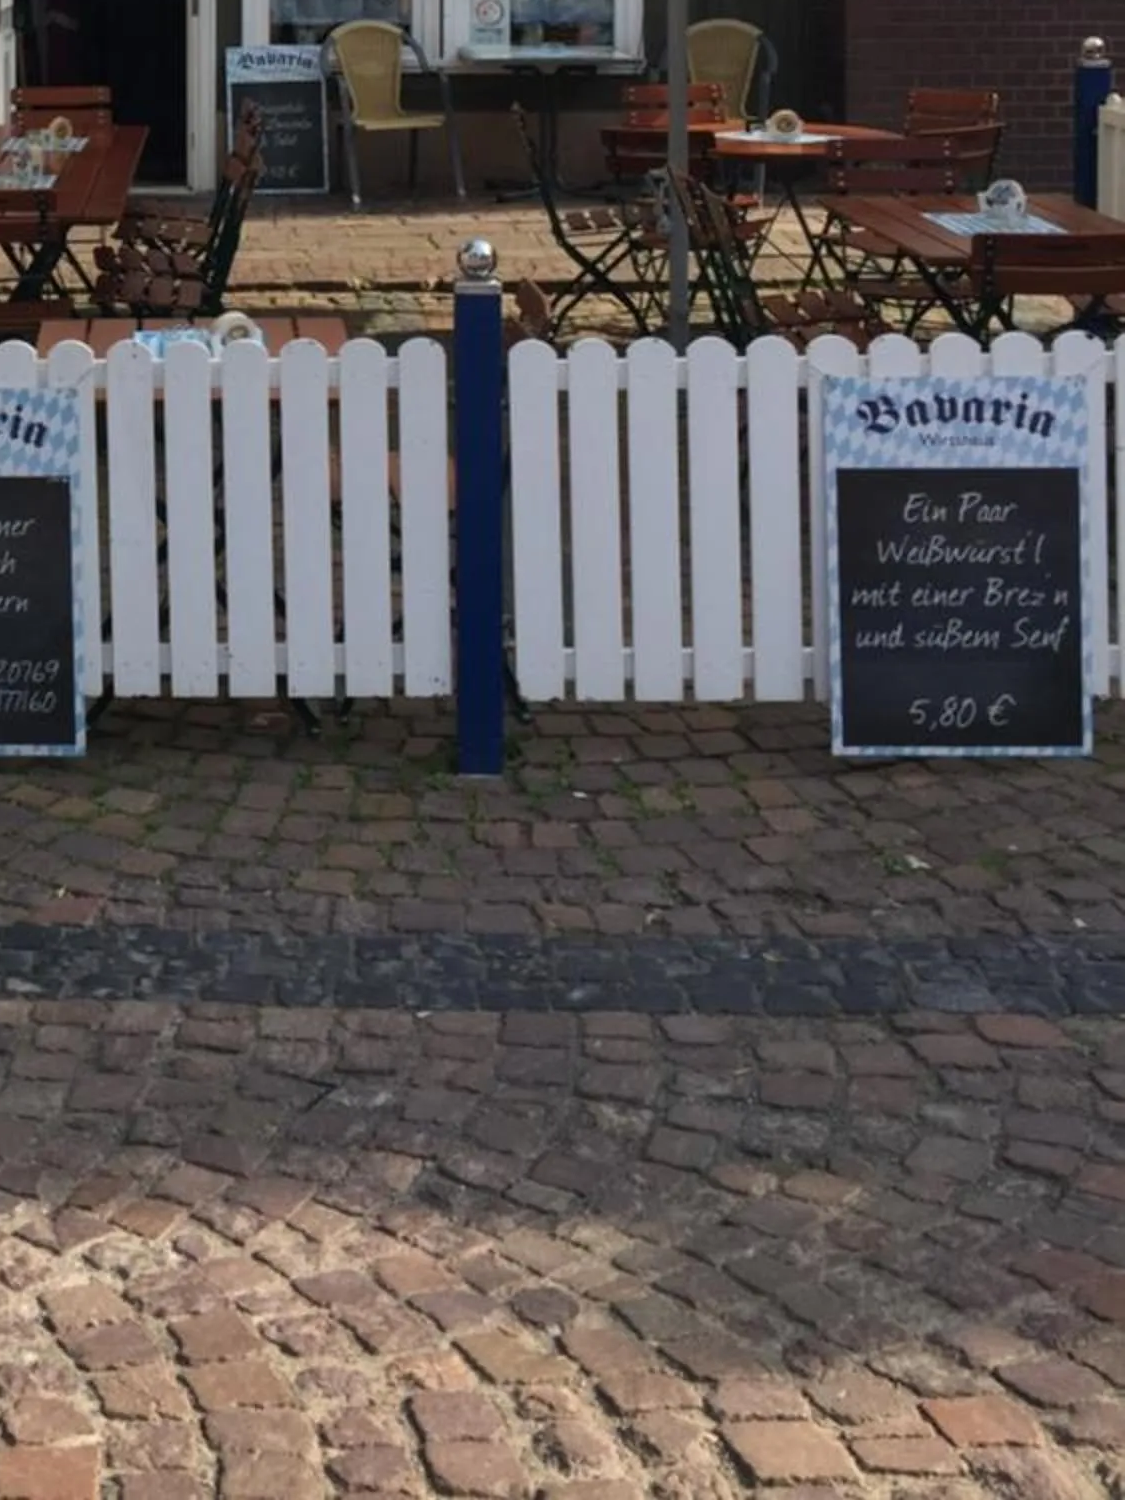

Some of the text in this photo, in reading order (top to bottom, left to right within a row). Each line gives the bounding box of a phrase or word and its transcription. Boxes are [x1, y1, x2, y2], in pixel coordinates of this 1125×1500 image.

[856, 392, 1057, 439] Bavaria
[903, 491, 1018, 524] Ein Paar
[851, 582, 901, 608] mit
[911, 587, 976, 608] einer
[856, 614, 1071, 655] und süßem Senf
[909, 694, 1017, 731] 5,80 €
